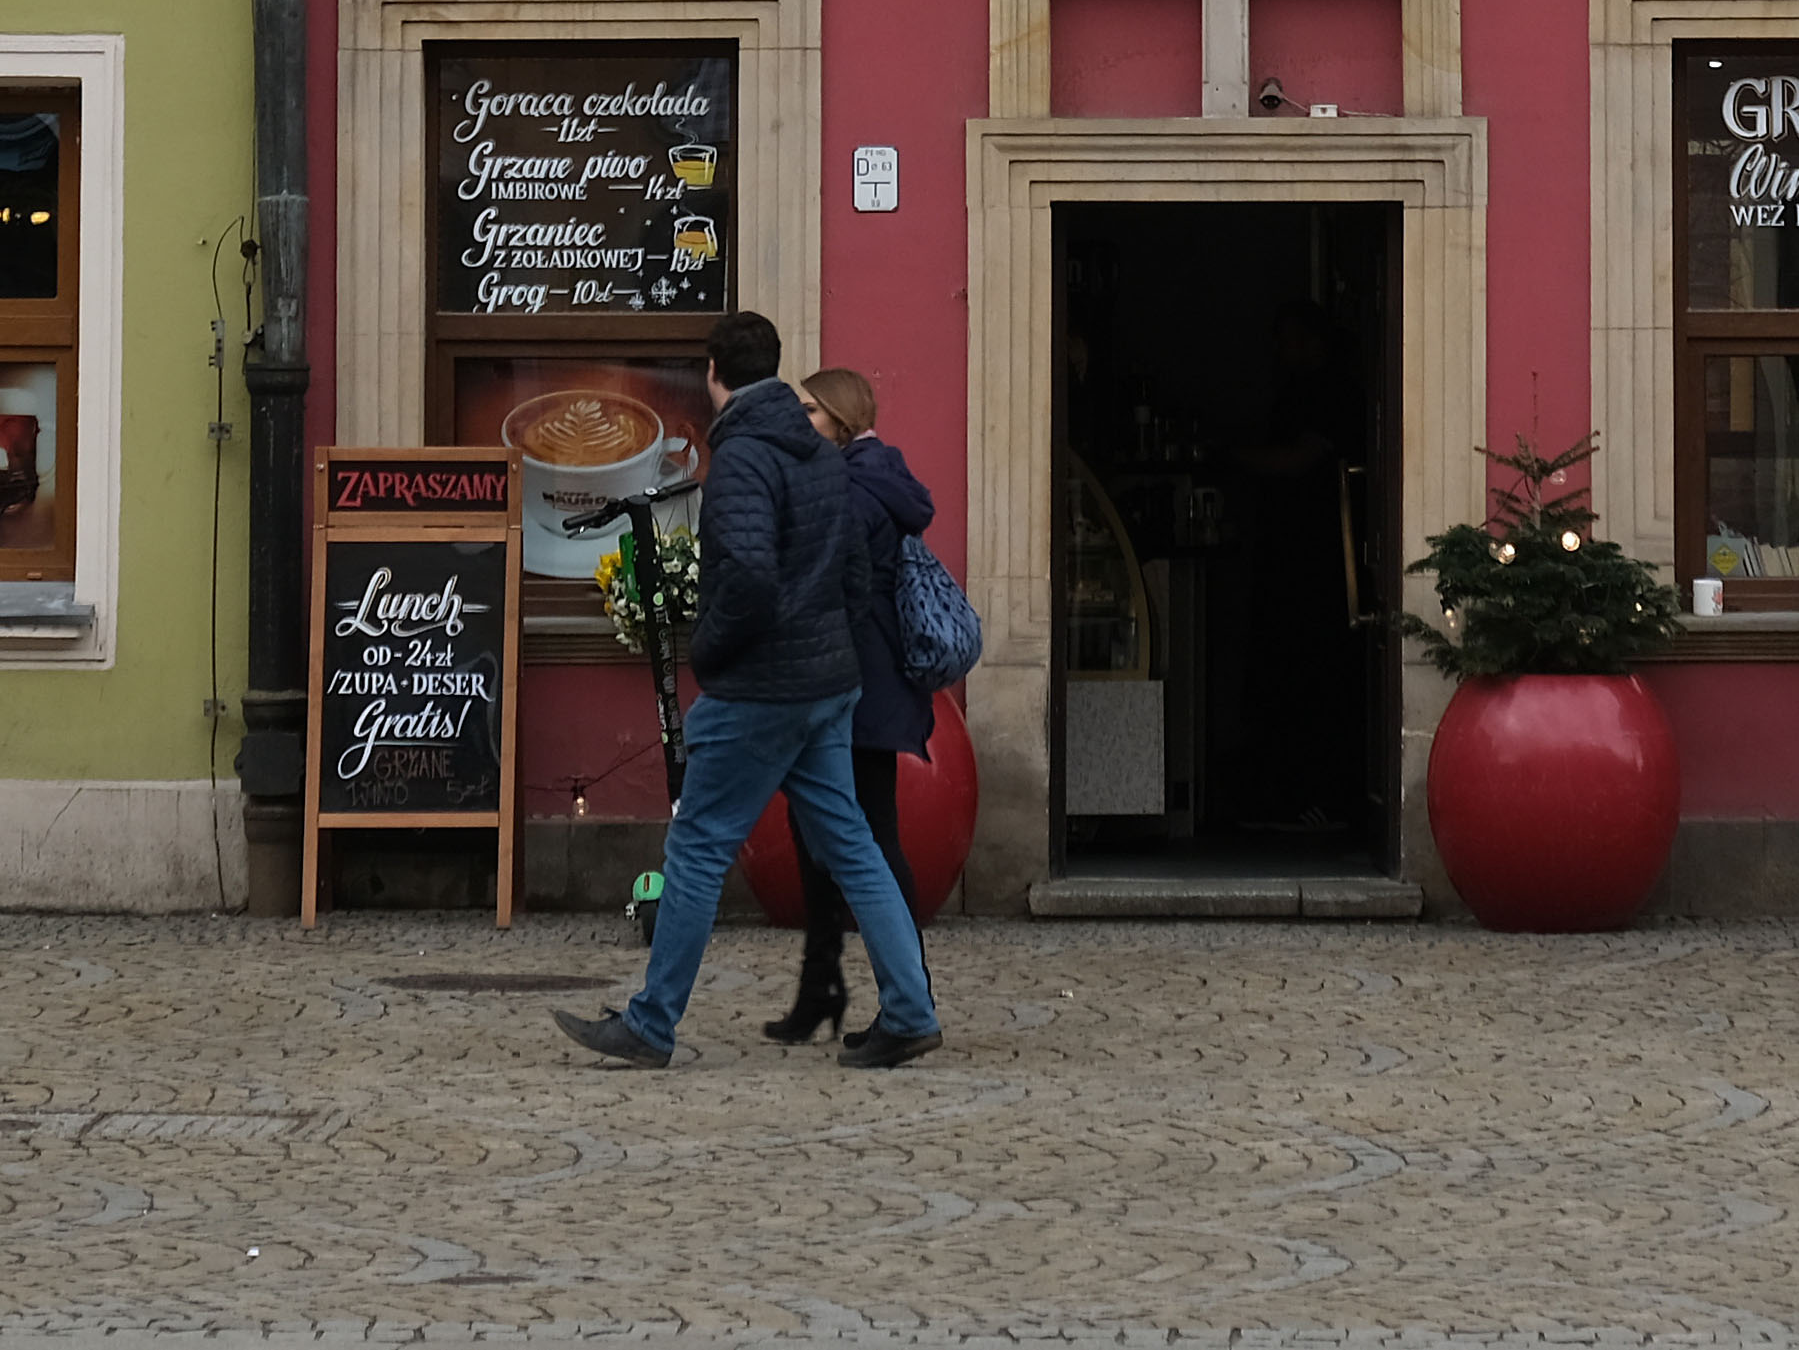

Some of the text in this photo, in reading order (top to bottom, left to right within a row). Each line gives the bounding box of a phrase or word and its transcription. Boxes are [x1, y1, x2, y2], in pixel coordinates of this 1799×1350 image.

[583, 81, 711, 117] czekolada
[457, 139, 652, 200] Grzane piwo
[490, 181, 588, 200] IMBIROWE
[461, 205, 606, 268] Grzaniec
[473, 271, 550, 314] Grog
[336, 471, 507, 508] ZAPRASZAMY
[335, 566, 465, 638] Lunch
[412, 673, 497, 703] DESER
